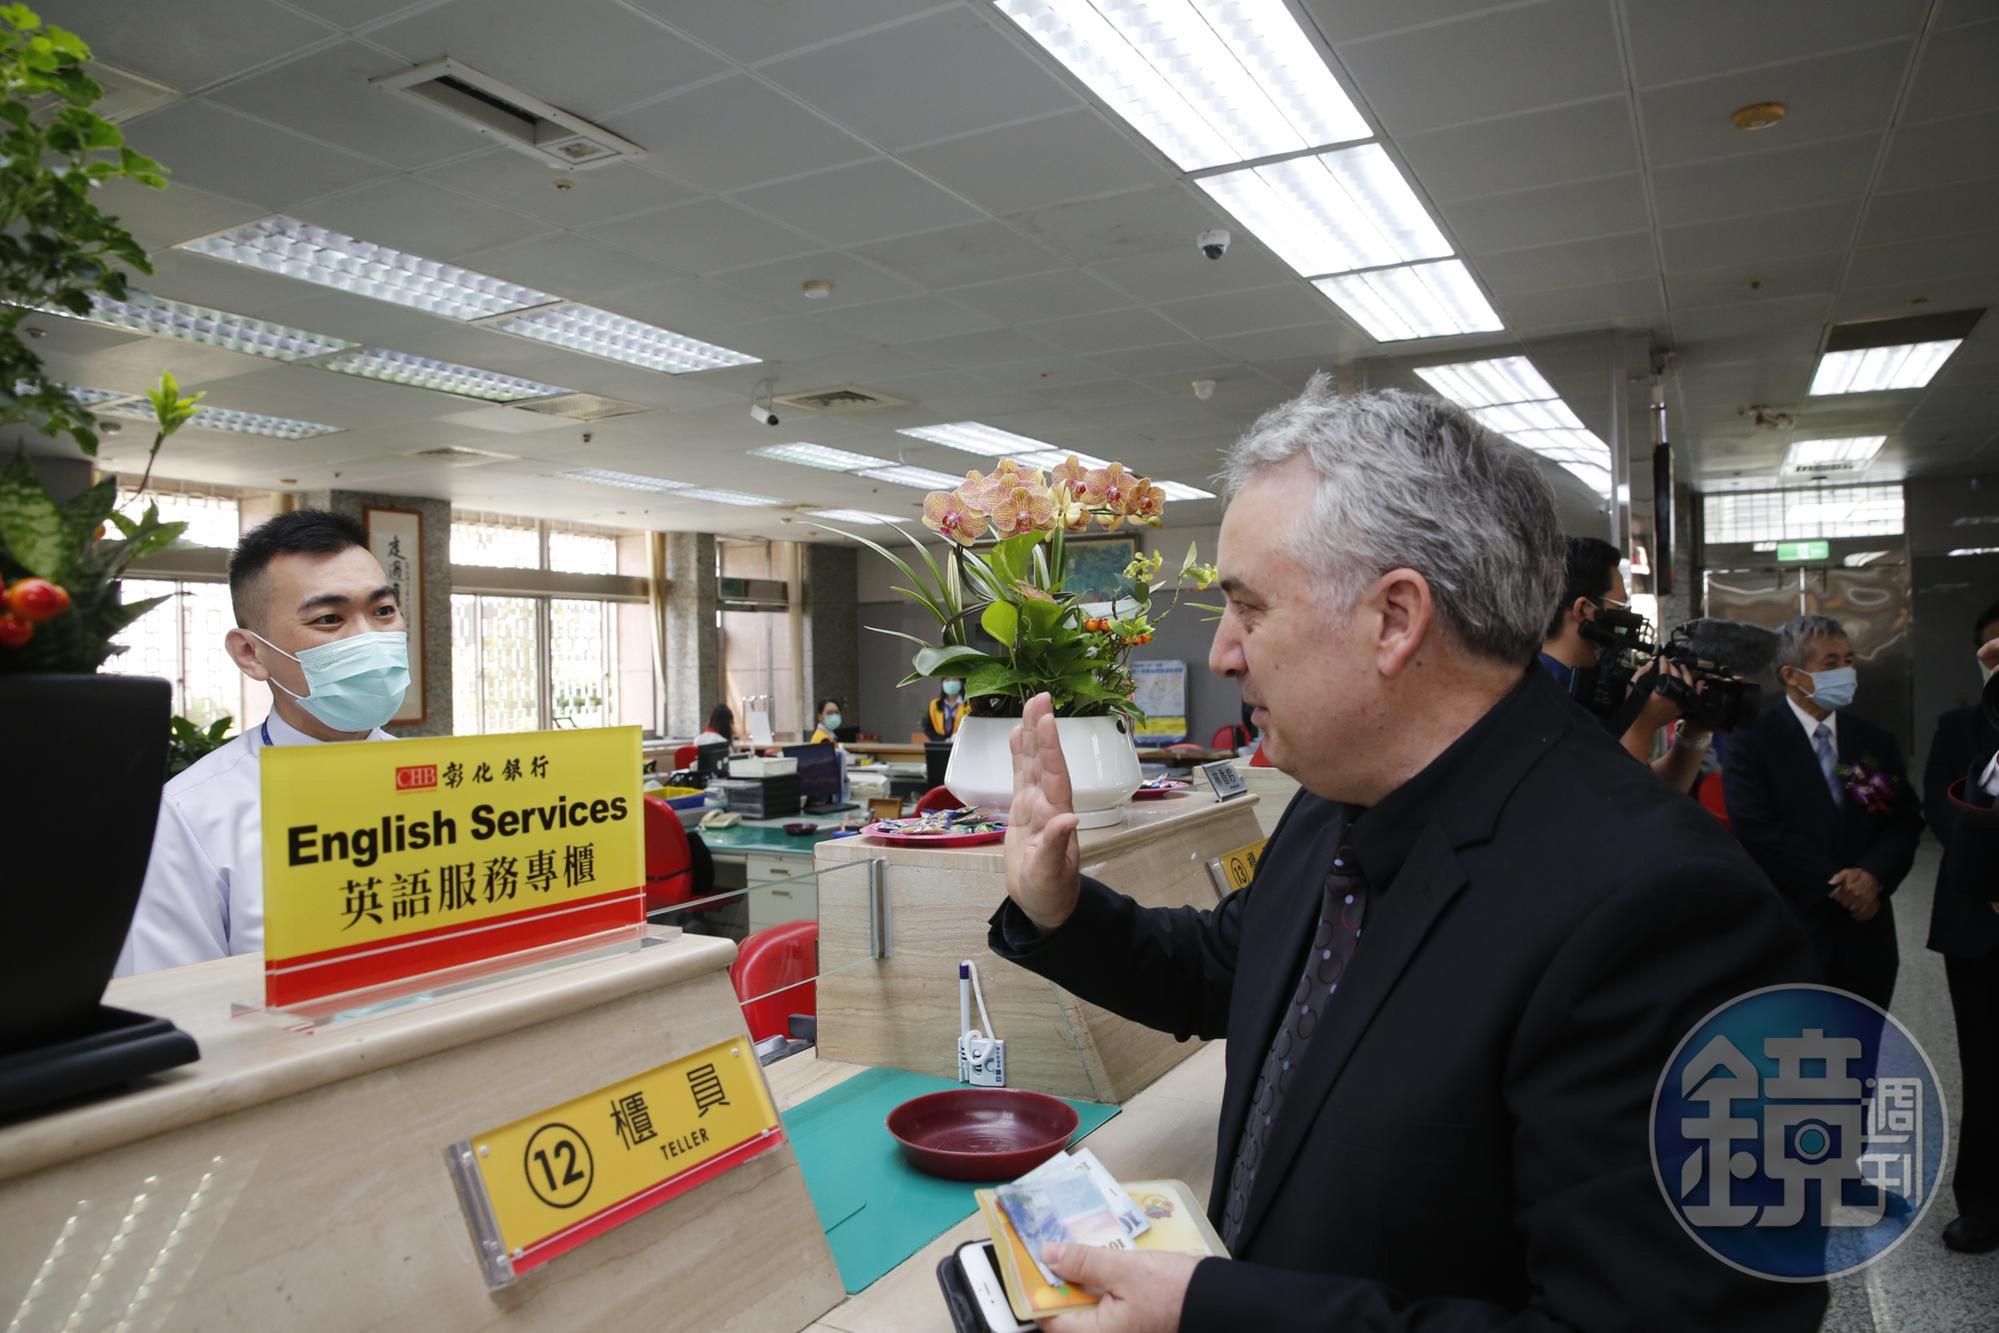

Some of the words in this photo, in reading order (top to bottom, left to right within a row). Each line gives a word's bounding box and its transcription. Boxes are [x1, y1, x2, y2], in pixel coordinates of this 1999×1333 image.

[396, 766, 436, 788] CHB
[442, 754, 549, 789] 彰化銀行
[288, 810, 457, 868] English
[470, 795, 628, 841] Services
[340, 842, 597, 932] 英語服務專櫃
[533, 1139, 585, 1192] 12
[610, 1063, 730, 1150] 櫃員
[660, 1127, 710, 1160] TELLER
